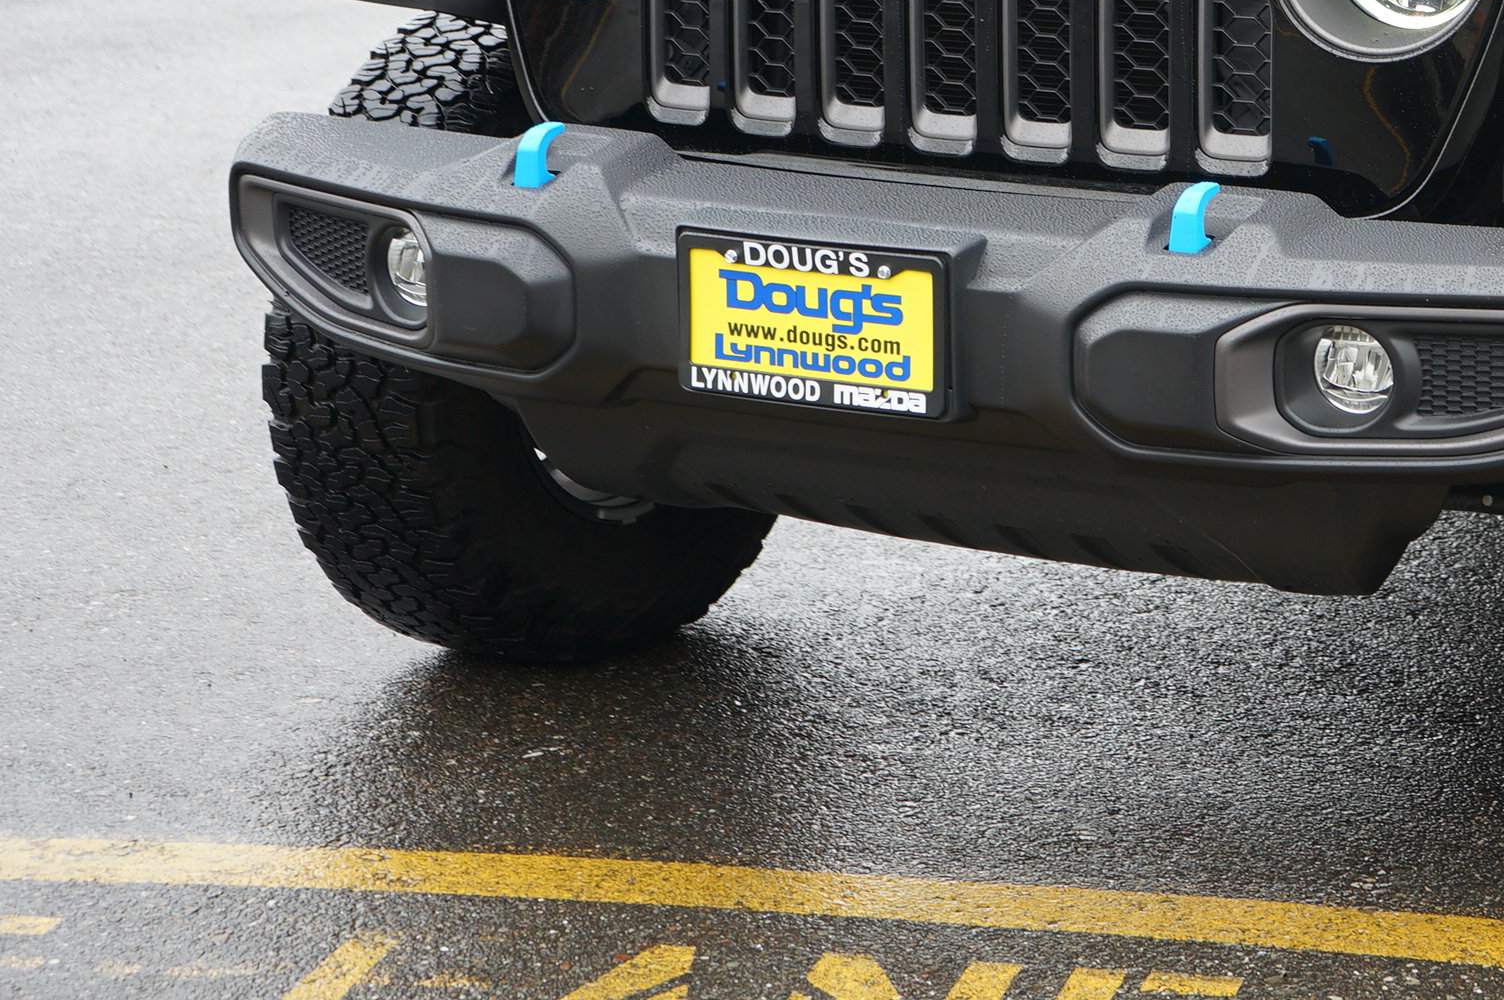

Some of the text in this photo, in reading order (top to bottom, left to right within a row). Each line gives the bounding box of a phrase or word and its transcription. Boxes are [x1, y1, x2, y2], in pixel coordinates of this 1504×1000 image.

[743, 242, 869, 277] DOUG'S
[728, 322, 901, 355] www.dougs.com
[715, 333, 911, 381] Lynnwood
[691, 367, 820, 402] LYNNWOOD
